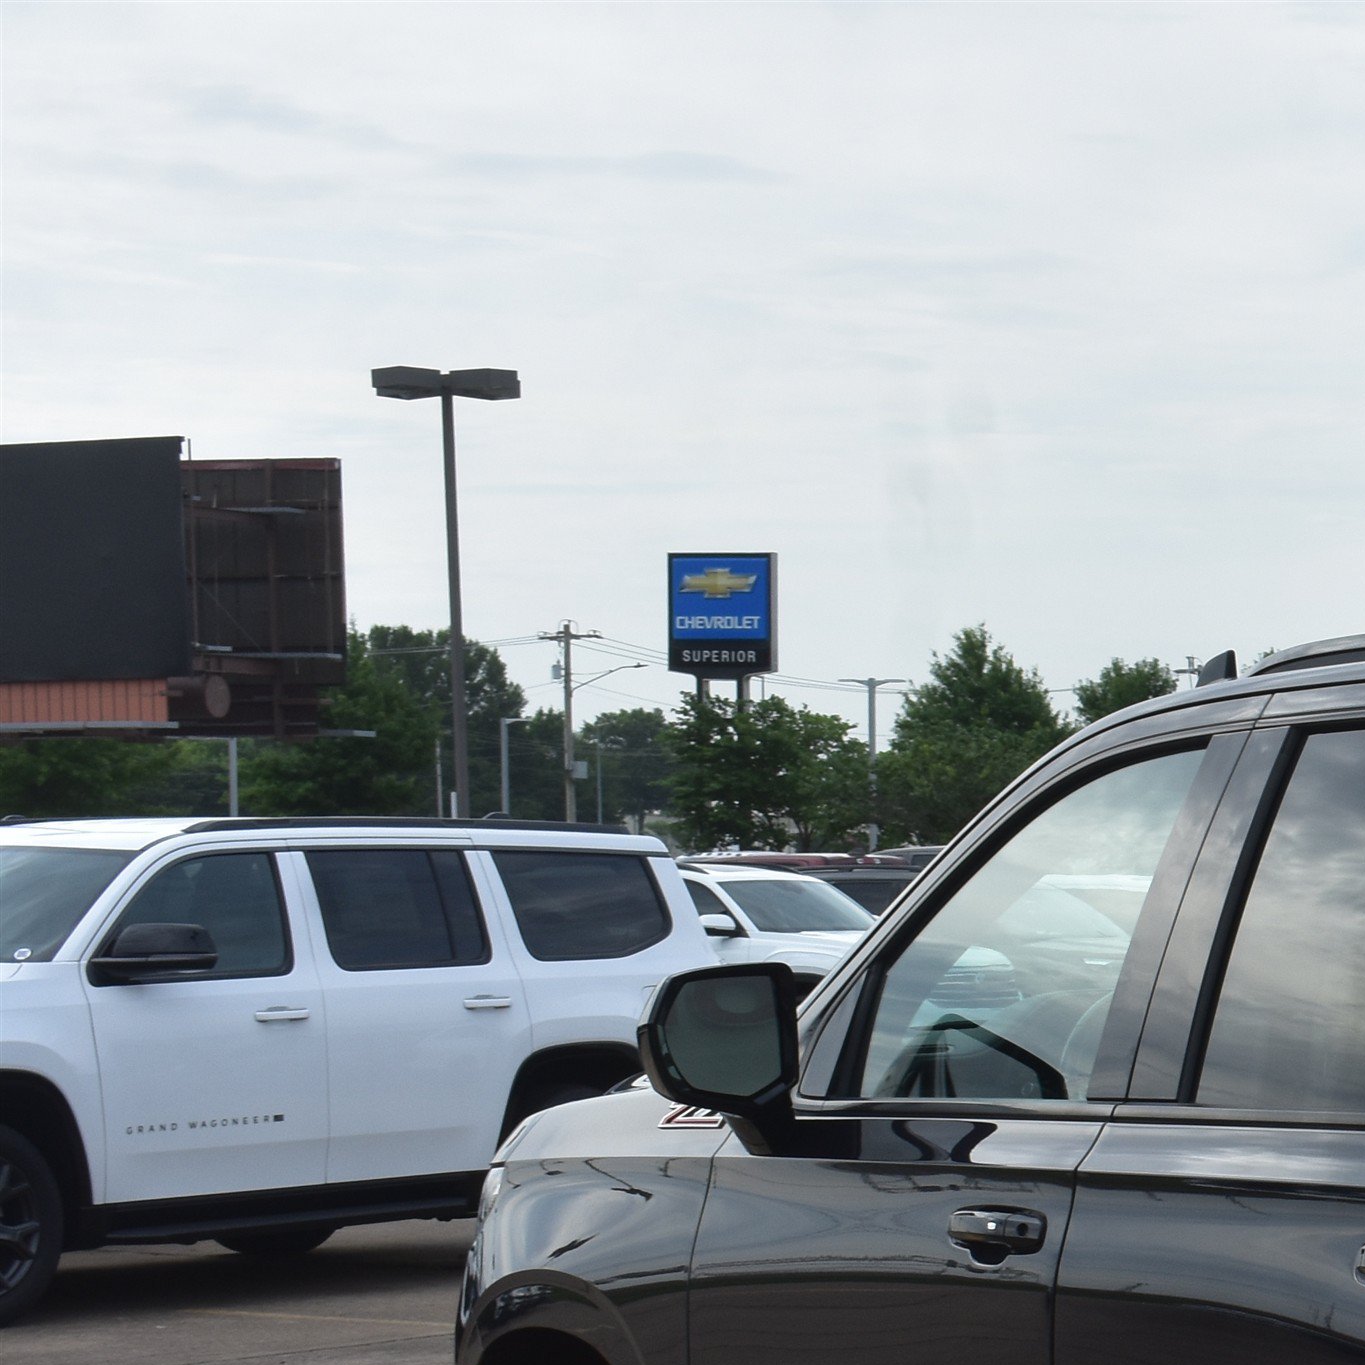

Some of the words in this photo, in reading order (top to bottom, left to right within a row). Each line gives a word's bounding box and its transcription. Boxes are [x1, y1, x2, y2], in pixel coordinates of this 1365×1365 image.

[675, 616, 761, 629] CHEVROLET
[682, 650, 757, 662] SUPERIOR
[126, 1122, 178, 1135] GRAND
[188, 1114, 270, 1129] WAGONEER
